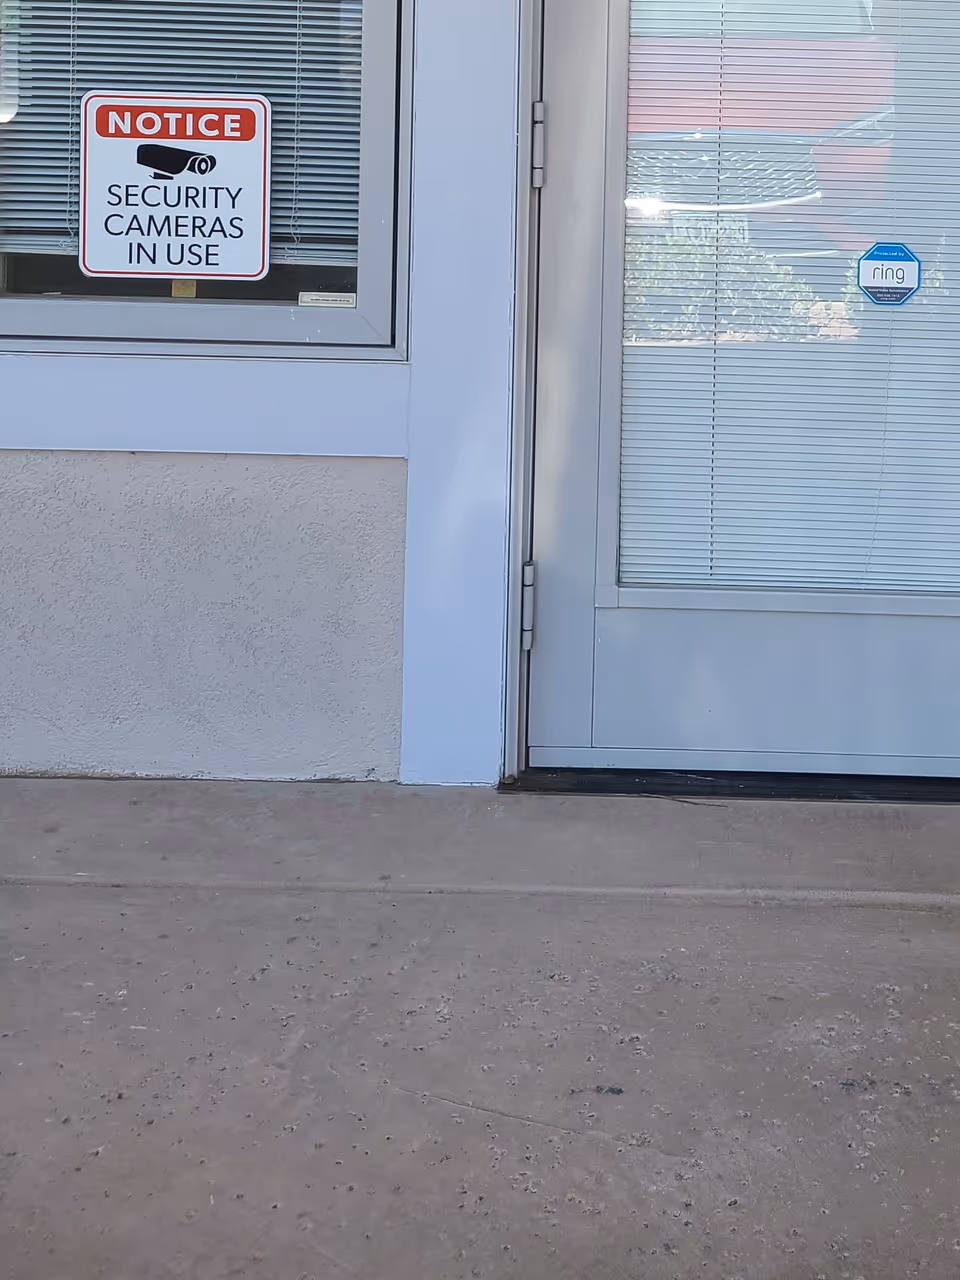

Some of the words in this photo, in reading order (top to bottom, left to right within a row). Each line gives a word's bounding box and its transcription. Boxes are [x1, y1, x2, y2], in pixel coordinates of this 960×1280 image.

[107, 110, 242, 137] NOTICE
[106, 184, 244, 210] SECURITY
[103, 213, 244, 239] CAMERAS
[127, 242, 157, 266] IN
[165, 243, 220, 267] USE
[872, 263, 905, 285] ring
